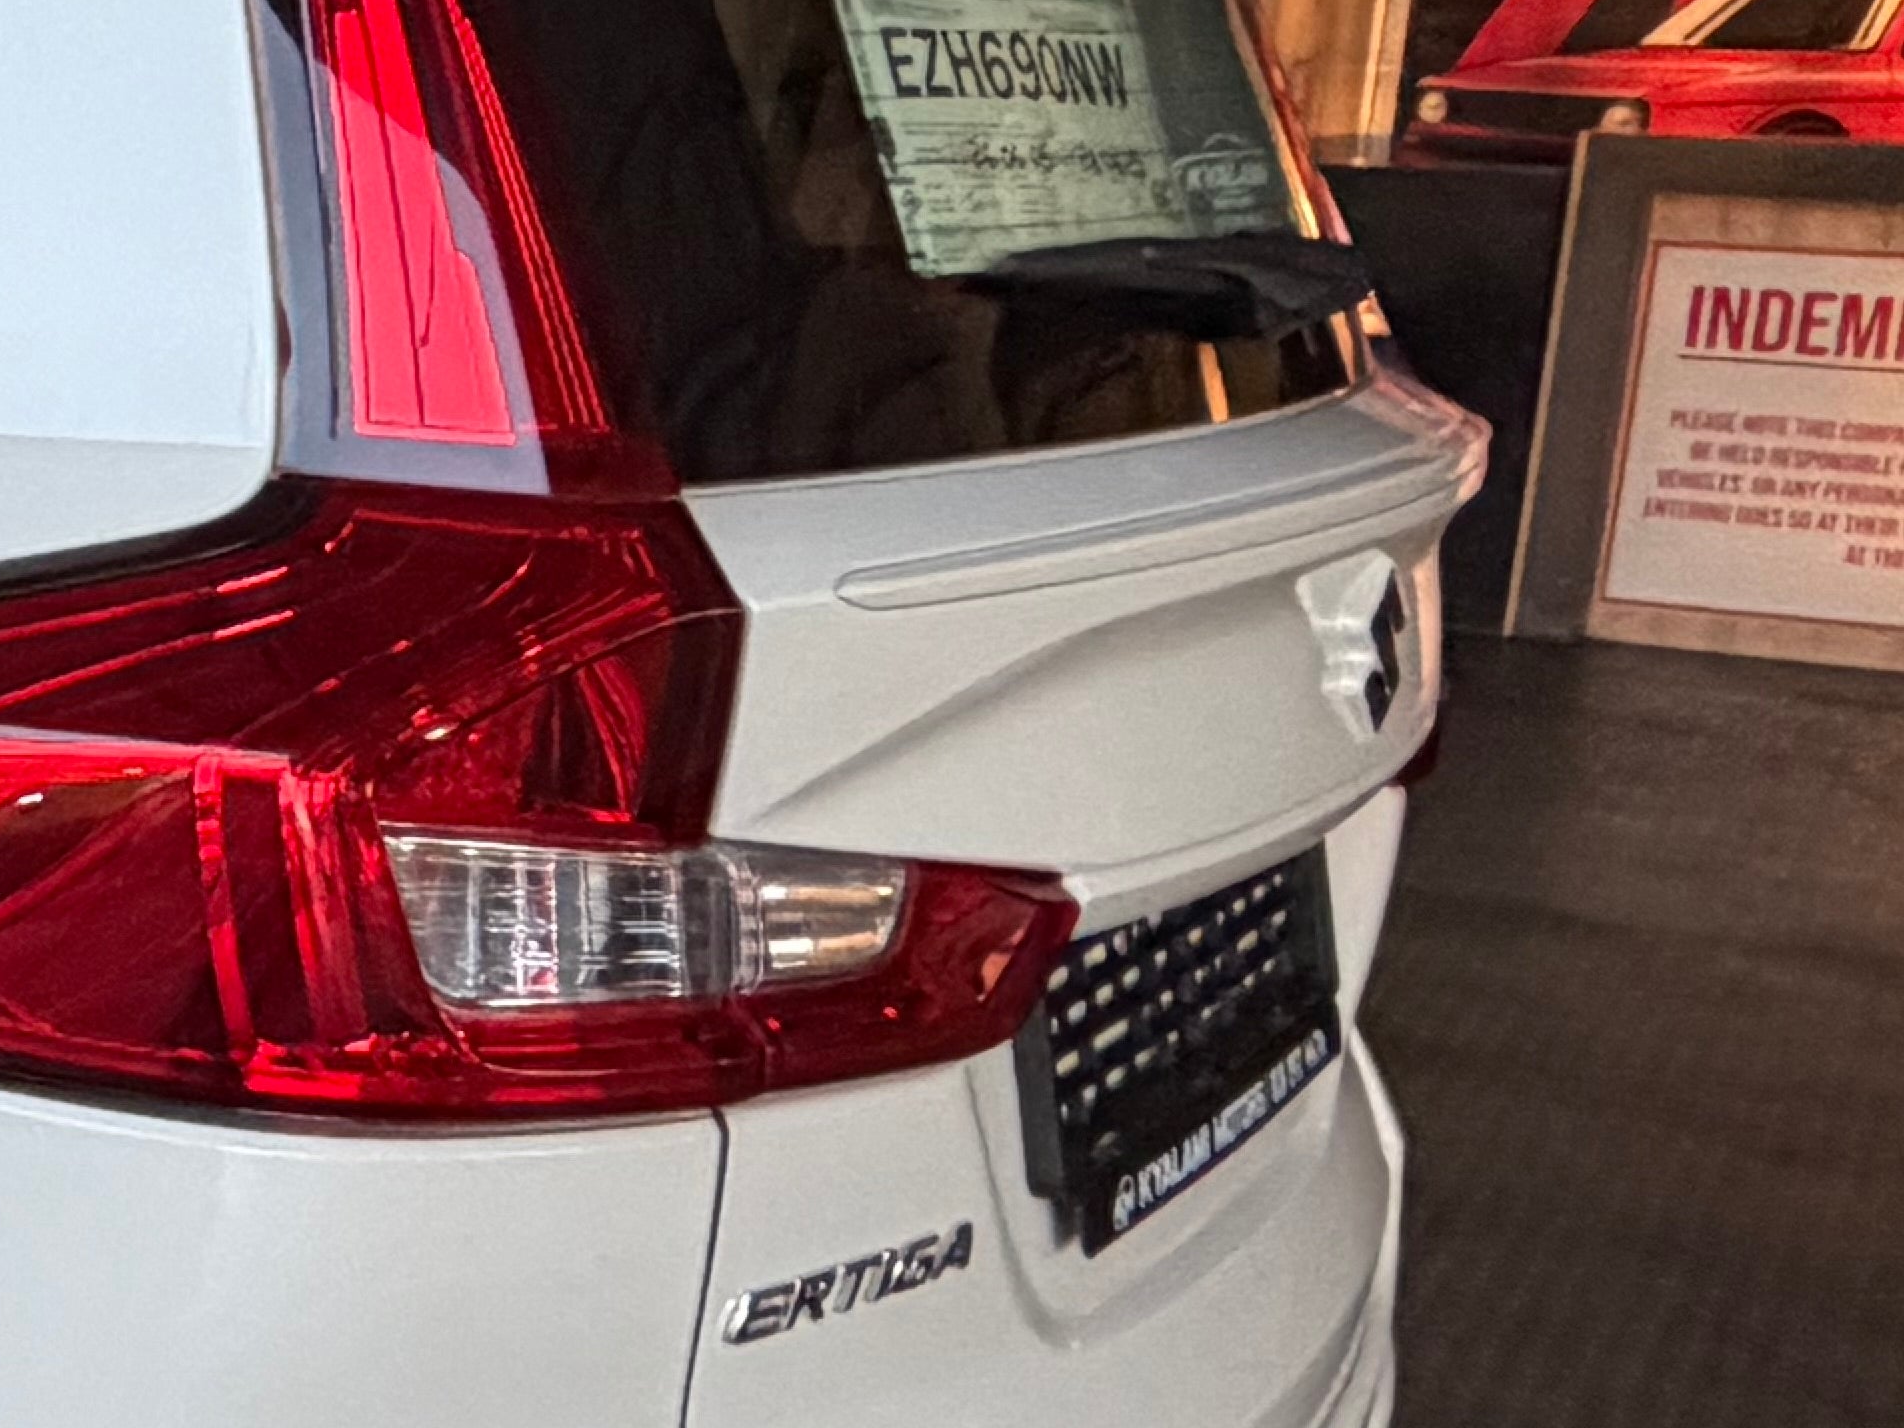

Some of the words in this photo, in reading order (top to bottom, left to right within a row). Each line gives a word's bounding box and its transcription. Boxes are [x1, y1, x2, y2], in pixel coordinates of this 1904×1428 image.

[880, 27, 1129, 108] EZH690NW
[1684, 285, 1904, 362] INDEM
[722, 1220, 974, 1345] ERTIGA
